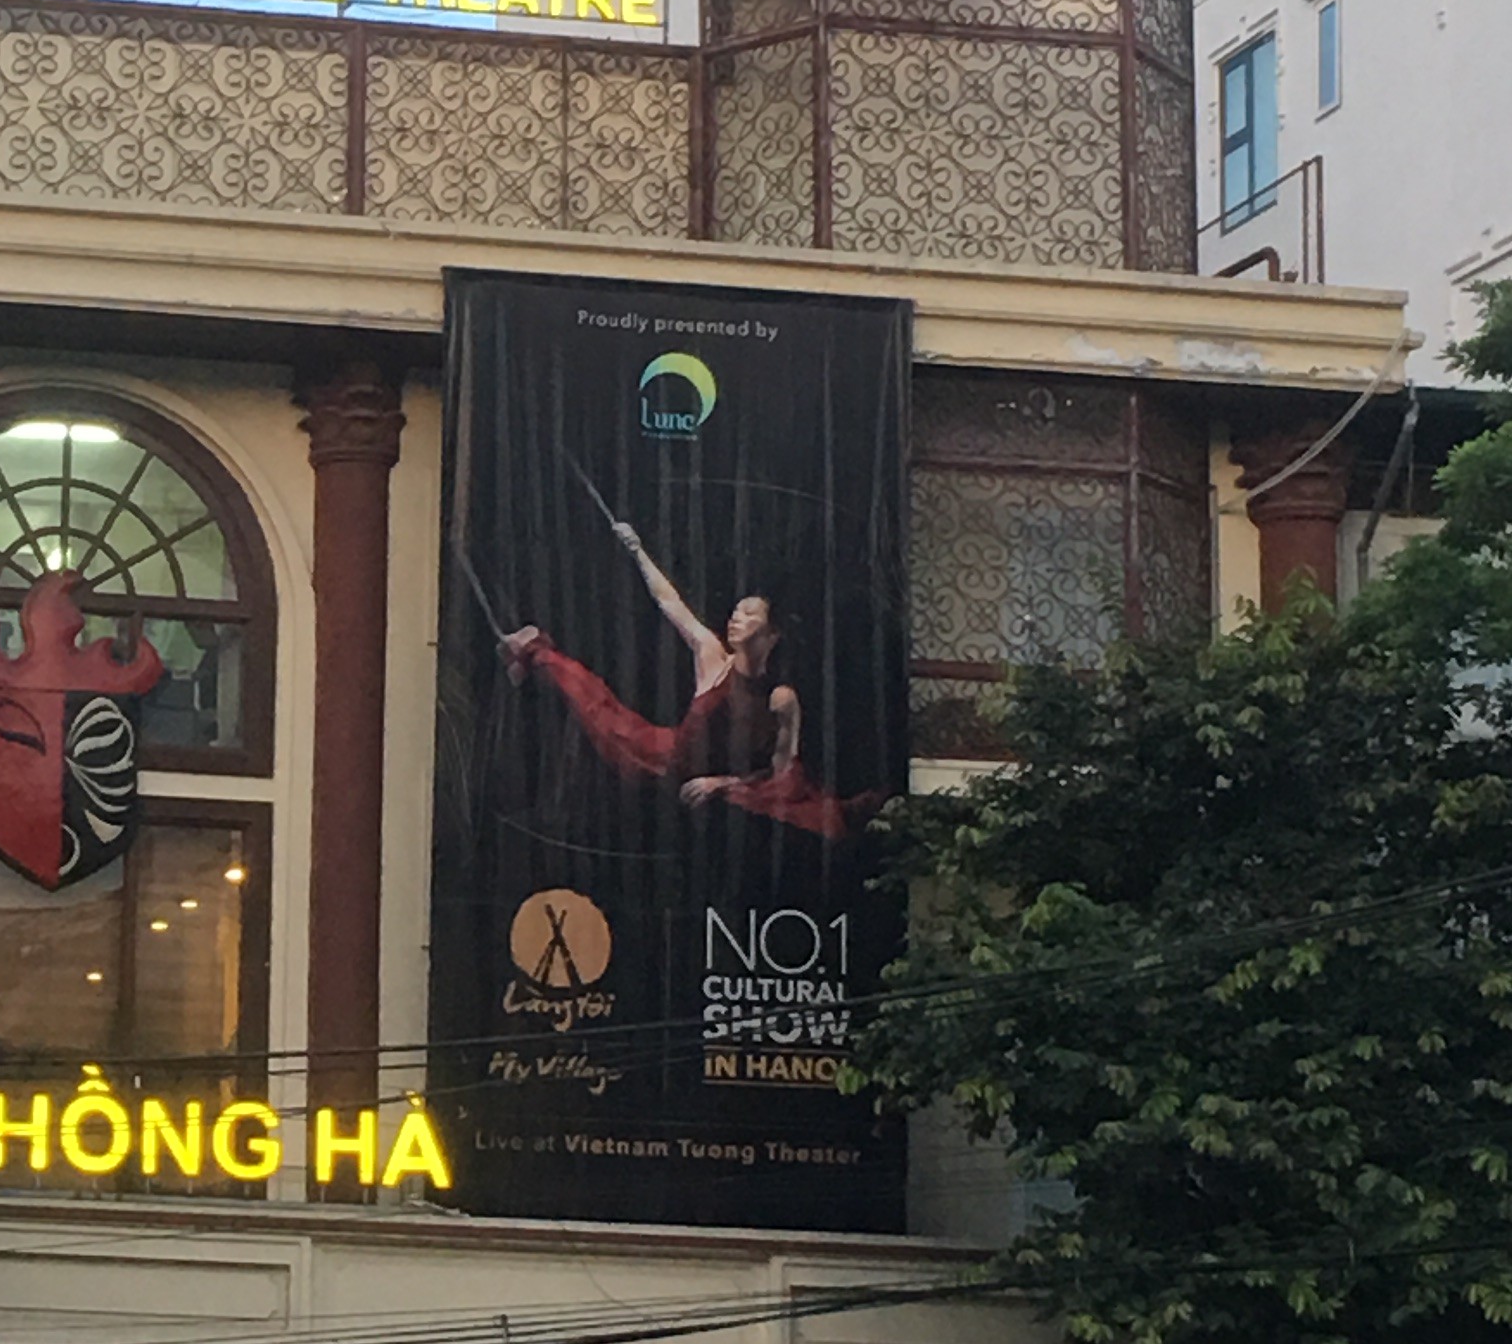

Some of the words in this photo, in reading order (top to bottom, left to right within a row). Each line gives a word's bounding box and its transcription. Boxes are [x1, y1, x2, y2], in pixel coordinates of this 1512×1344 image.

[577, 309, 648, 333] Proudly
[654, 318, 749, 337] presented
[755, 321, 779, 341] by
[705, 906, 847, 975] NO.1
[702, 975, 845, 1003] CULTURAL
[702, 1004, 851, 1045] SHOW
[703, 1055, 737, 1077] IN
[314, 1090, 453, 1189] HÀ
[475, 1130, 524, 1150] Live
[533, 1135, 556, 1152] at
[564, 1134, 669, 1157] Vietnam
[677, 1138, 755, 1165] Tuong
[764, 1142, 861, 1164] Theater
